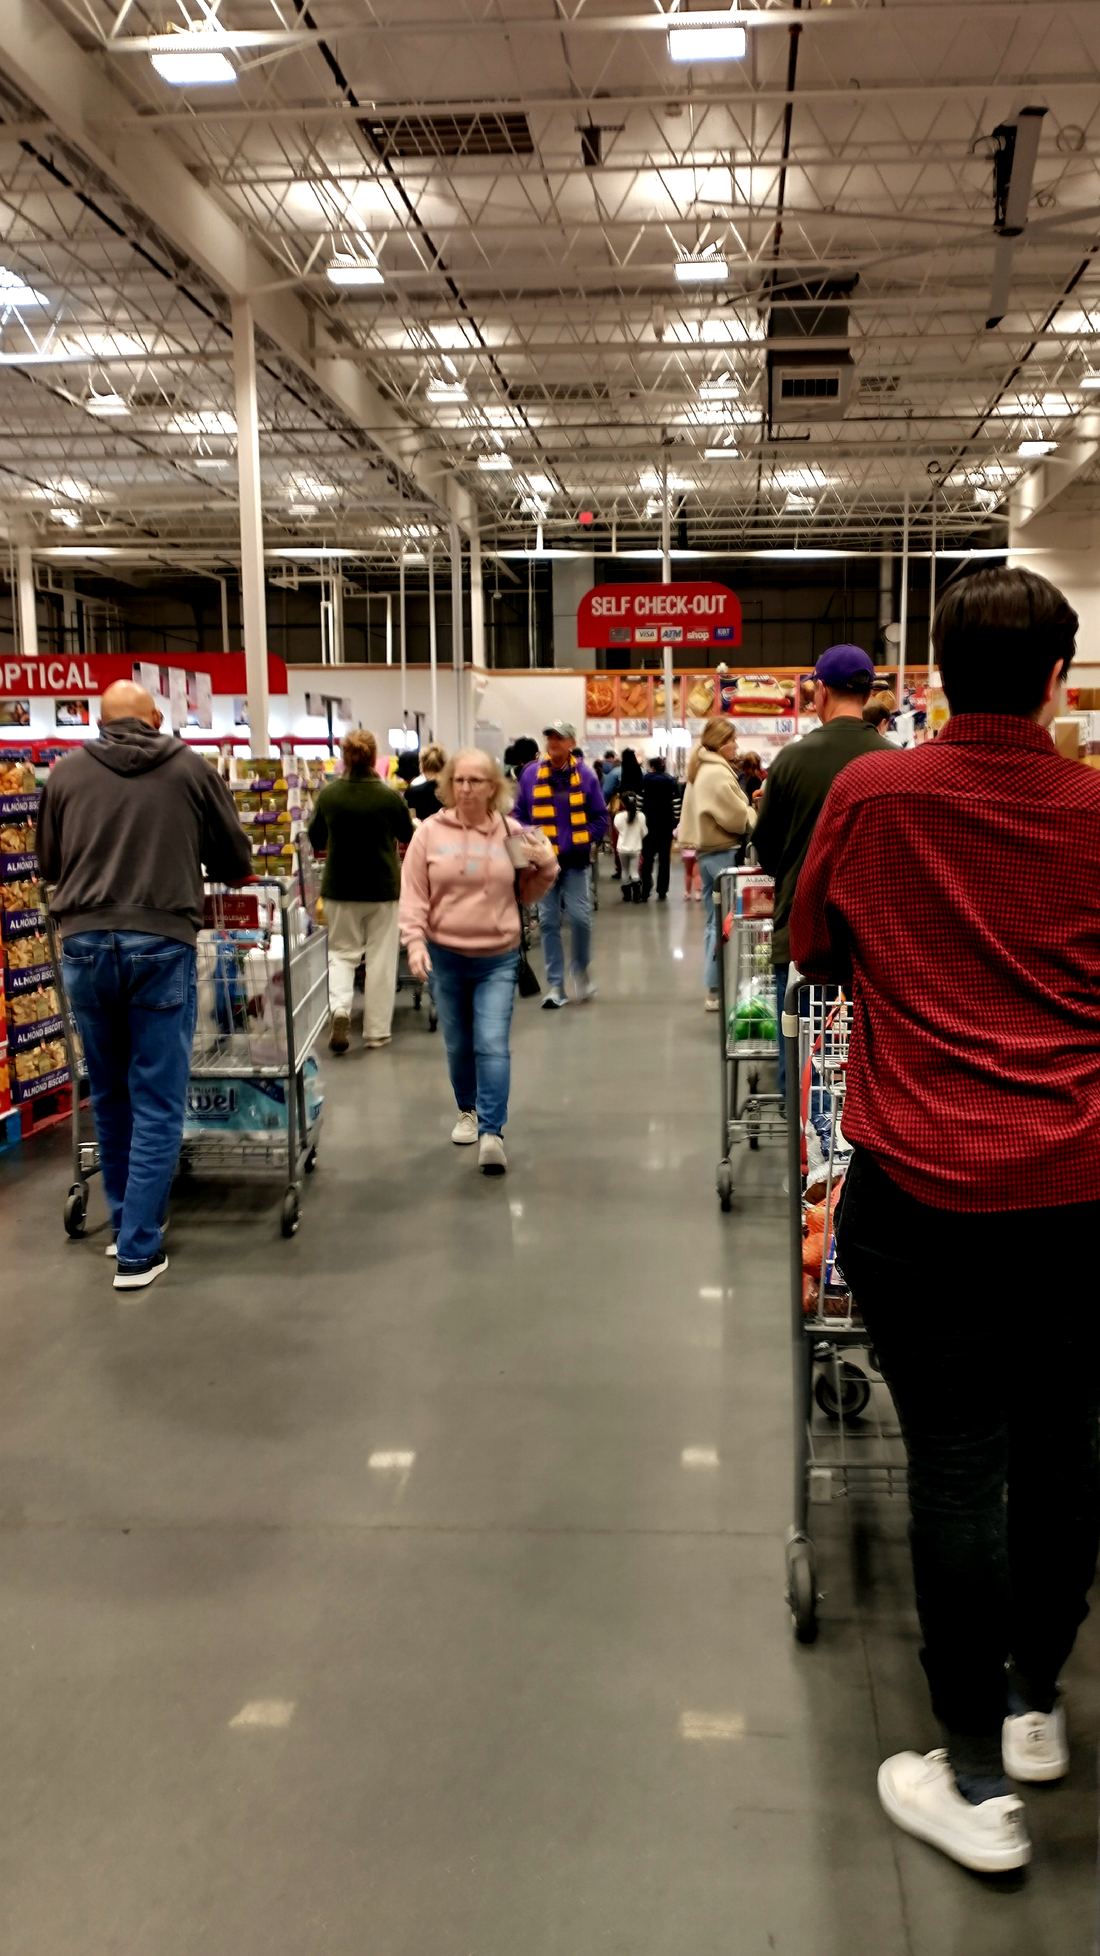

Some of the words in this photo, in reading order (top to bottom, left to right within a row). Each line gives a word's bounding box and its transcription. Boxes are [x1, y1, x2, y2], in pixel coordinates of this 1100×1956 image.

[591, 596, 631, 616] SELF
[634, 594, 727, 615] CHECK-OUT
[662, 629, 682, 639] ATM
[687, 630, 709, 641] shop
[0, 662, 99, 689] PTICAL
[2, 801, 28, 813] ALMOND
[7, 860, 34, 872] ALMOND
[10, 916, 37, 930] ALMOND
[13, 973, 40, 988] ALMOND
[17, 1028, 43, 1043] ALMOND
[23, 1081, 47, 1099] ALMOND
